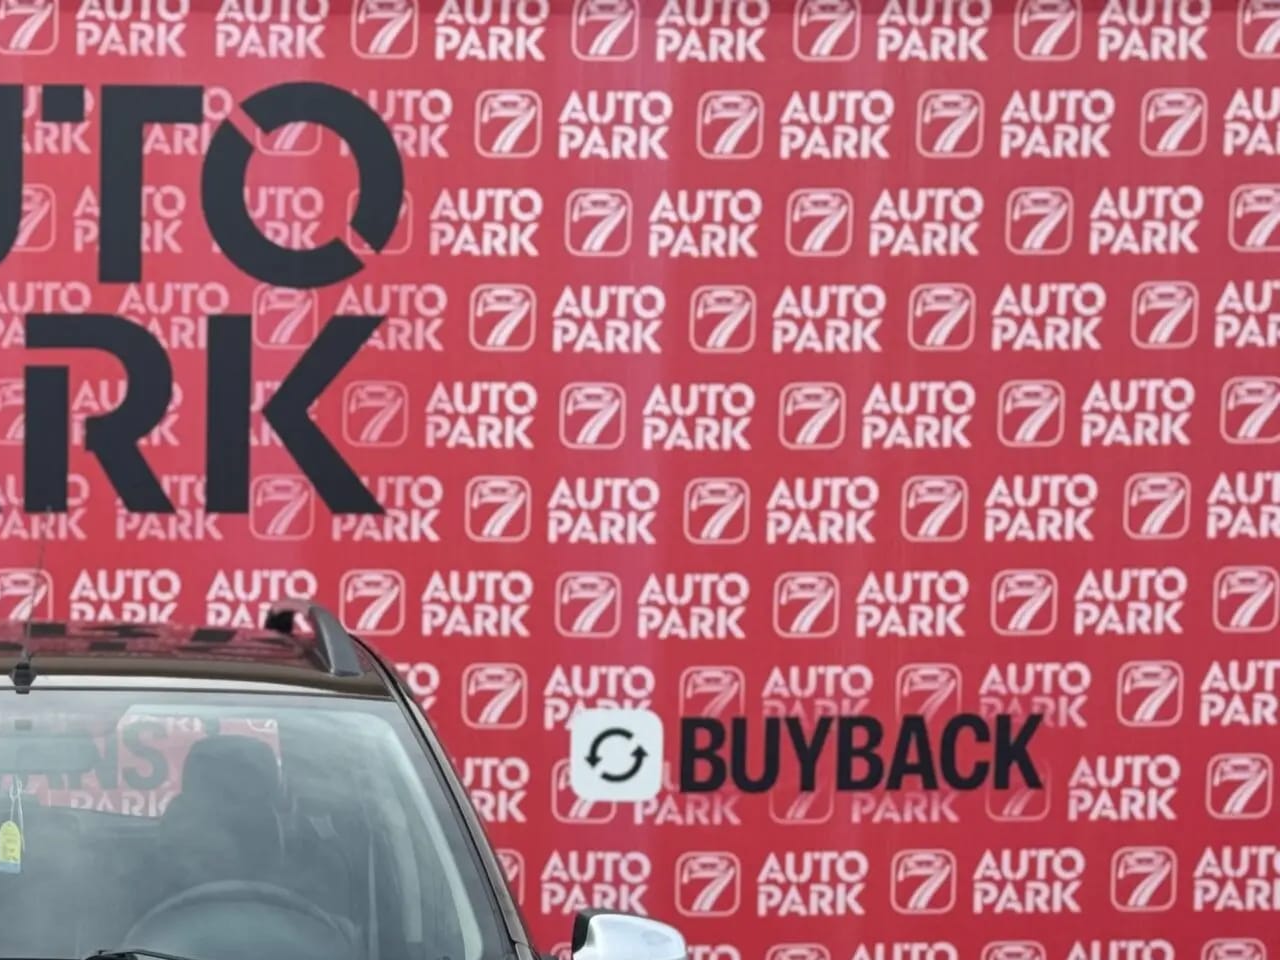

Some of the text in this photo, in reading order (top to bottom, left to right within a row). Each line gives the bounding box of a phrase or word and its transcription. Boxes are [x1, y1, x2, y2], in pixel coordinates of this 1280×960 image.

[77, 21, 185, 57] PARK
[216, 23, 324, 58] PARK
[435, 26, 544, 61] PARK
[656, 26, 765, 62] PARK
[877, 27, 987, 61] PARK
[1098, 26, 1207, 61] PARK
[559, 91, 672, 124] AUTO
[781, 90, 894, 124] AUTO
[1001, 89, 1115, 123] AUTO
[559, 124, 668, 159] PARK
[780, 125, 889, 159] PARK
[1001, 124, 1110, 158] PARK
[431, 188, 542, 221] AUTO
[649, 189, 762, 223] AUTO
[870, 188, 983, 221] AUTO
[1090, 186, 1203, 219] AUTO
[431, 221, 538, 256] PARK
[649, 223, 757, 257] PARK
[869, 221, 978, 256] PARK
[1090, 219, 1198, 254] PARK
[553, 285, 665, 318] AUTO
[773, 284, 886, 318] AUTO
[992, 283, 1106, 316] AUTO
[553, 318, 661, 353] PARK
[773, 318, 881, 352] PARK
[992, 316, 1101, 350] PARK
[426, 382, 537, 414] AUTO
[643, 383, 755, 416] AUTO
[863, 381, 975, 414] AUTO
[1082, 378, 1195, 411] AUTO
[426, 414, 533, 448] PARK
[643, 416, 750, 450] PARK
[862, 414, 971, 449] PARK
[1081, 411, 1190, 446] PARK
[548, 477, 660, 509] AUTO
[767, 476, 879, 509] AUTO
[985, 474, 1098, 507] AUTO
[548, 509, 655, 544] PARK
[767, 509, 875, 543] PARK
[985, 507, 1093, 541] PARK
[422, 571, 533, 603] AUTO
[638, 573, 749, 605] AUTO
[856, 570, 969, 603] AUTO
[1075, 567, 1187, 600] AUTO
[422, 603, 529, 636] PARK
[638, 605, 745, 639] PARK
[856, 603, 964, 637] PARK
[1074, 600, 1183, 635] PARK
[680, 714, 1044, 793] BUYBACK
[1069, 755, 1180, 787] AUTO
[1069, 787, 1176, 820] PARK
[758, 850, 868, 883] AUTO
[973, 848, 1085, 880] AUTO
[758, 883, 864, 916] PARK
[973, 880, 1080, 913] PARK
